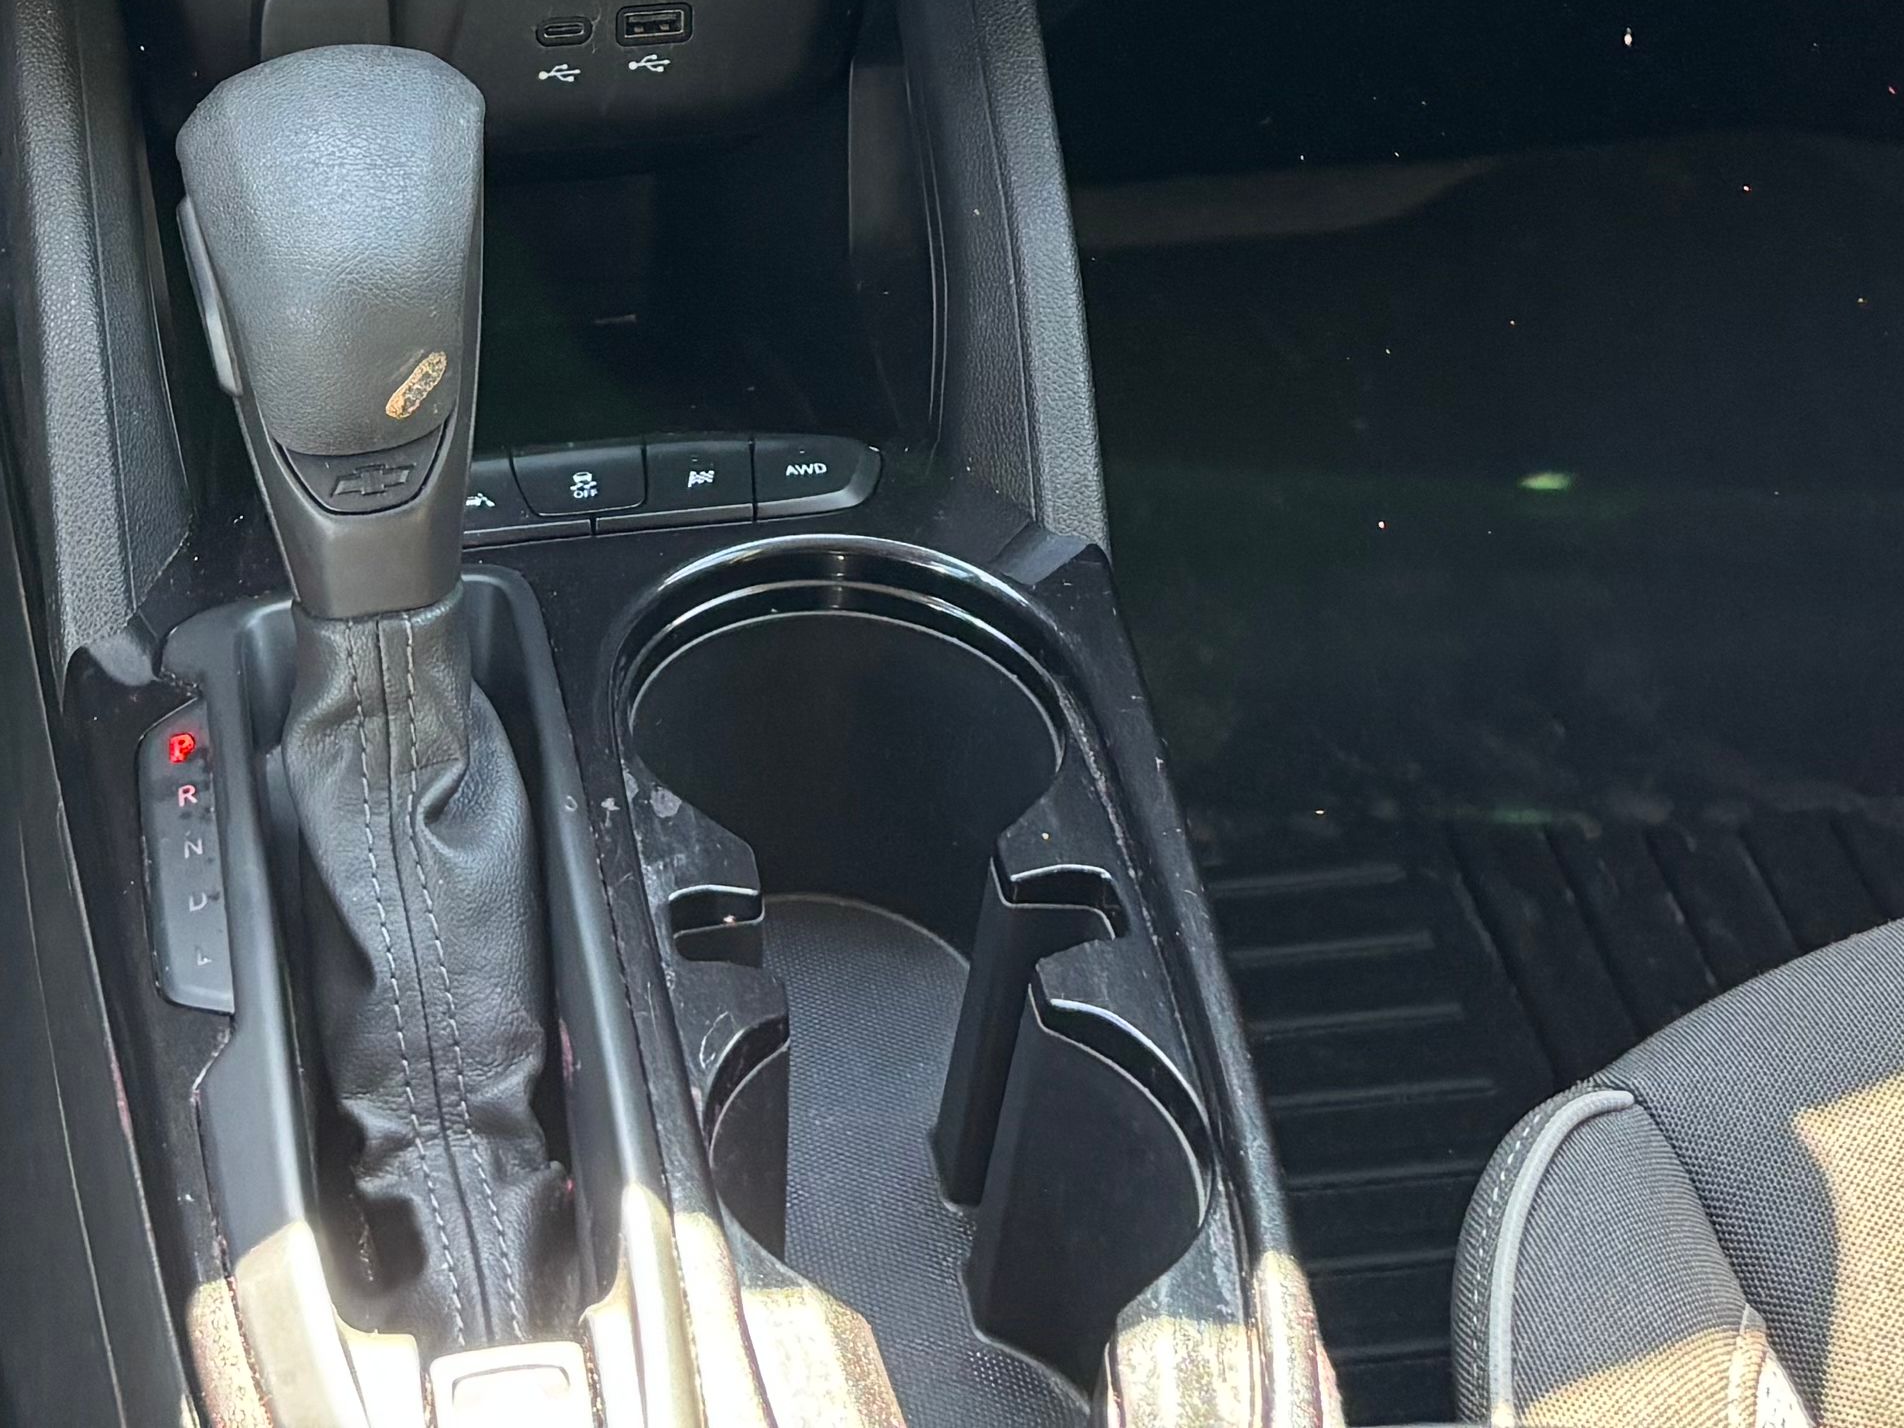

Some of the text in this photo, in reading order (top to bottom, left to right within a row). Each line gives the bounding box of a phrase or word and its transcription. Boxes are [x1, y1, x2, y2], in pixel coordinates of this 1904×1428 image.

[785, 461, 827, 477] AWD
[573, 488, 598, 500] OFF
[169, 732, 196, 764] P
[177, 784, 198, 807] R
